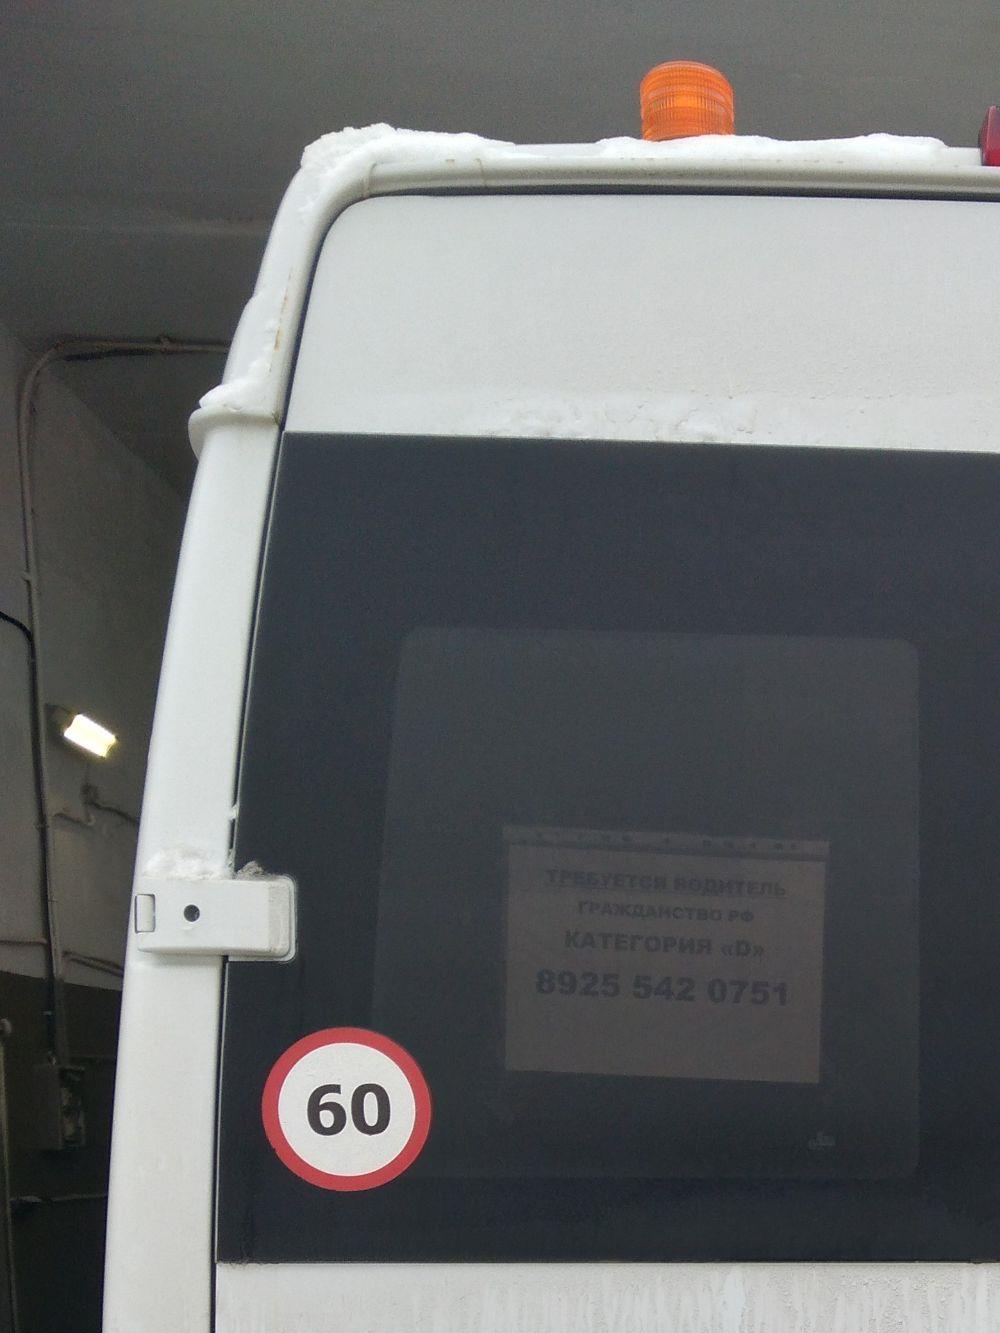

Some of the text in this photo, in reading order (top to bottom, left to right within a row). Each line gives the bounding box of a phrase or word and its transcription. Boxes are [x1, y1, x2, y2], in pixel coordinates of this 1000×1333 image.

[545, 868, 787, 897] ТРЕБУЕТСЯ ВОДИТЕЛЬ
[577, 900, 755, 923] ГРАЖДАНСТВО РФ
[564, 929, 766, 958] КАТЕГОРИЯ «D»
[535, 967, 788, 1006] 8925 542 0751
[306, 1082, 392, 1137] 60
